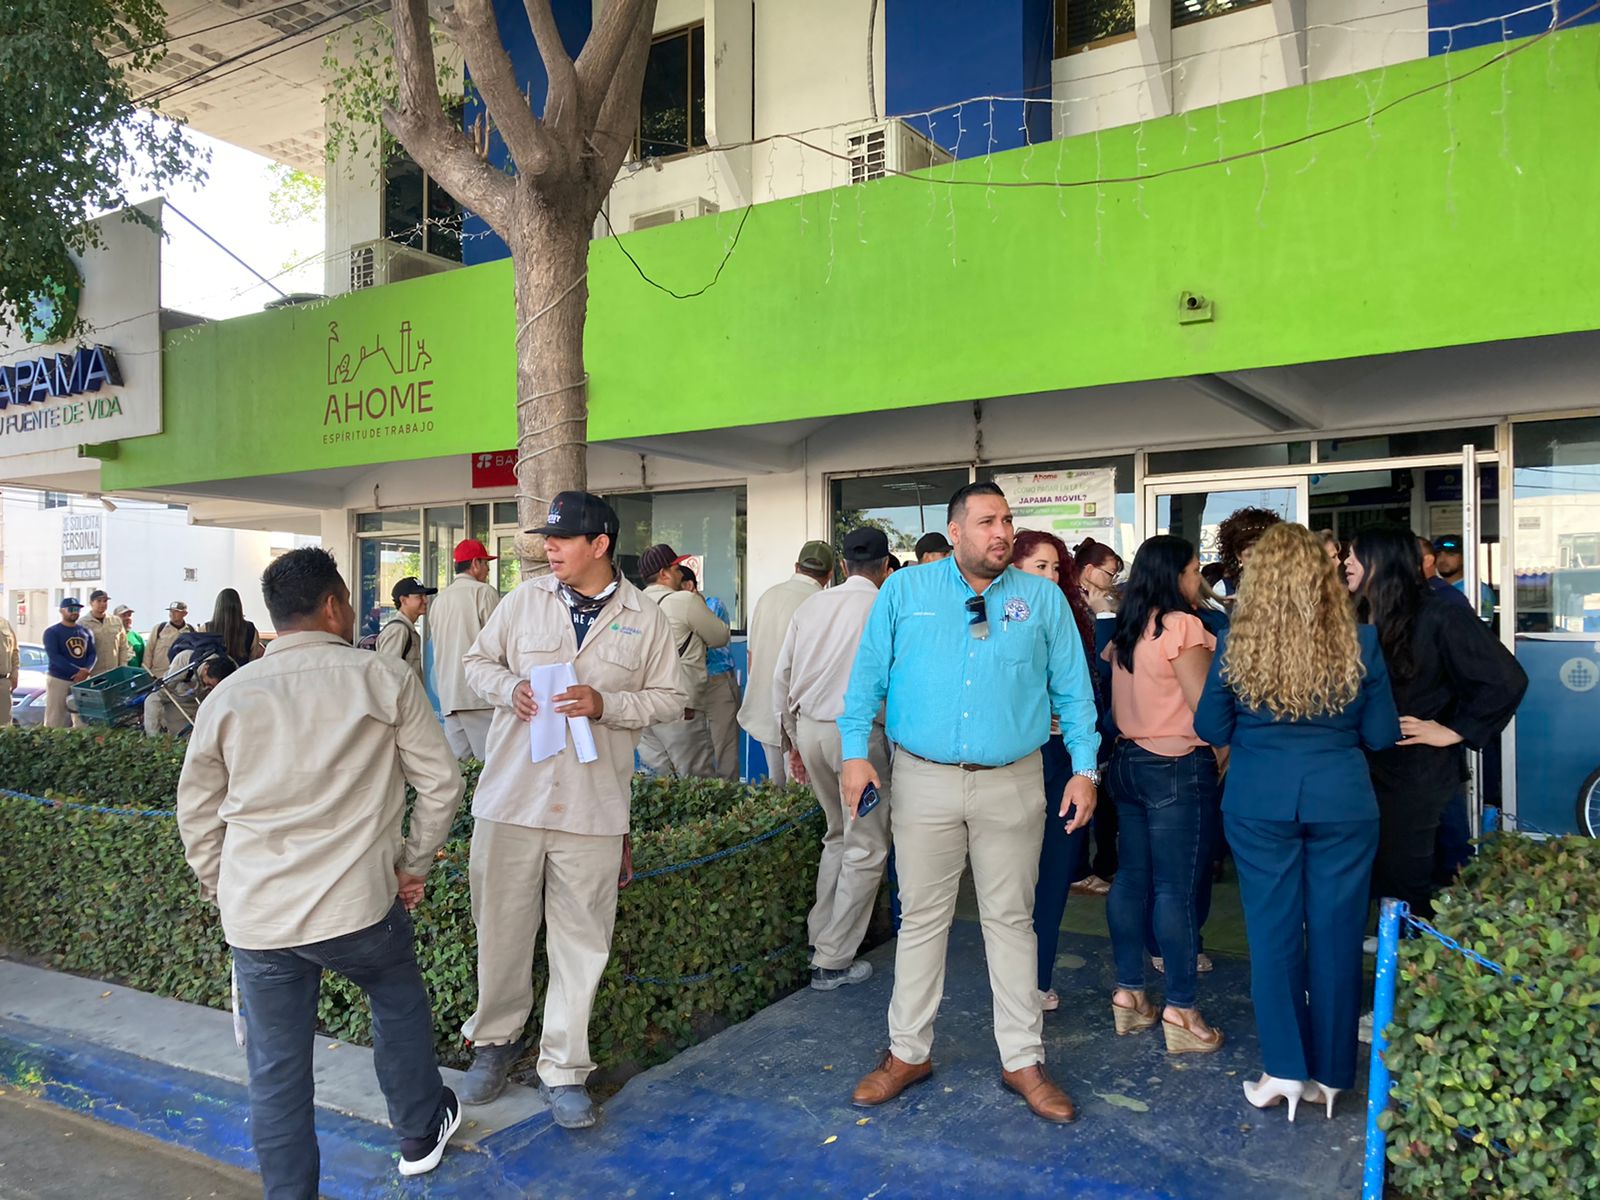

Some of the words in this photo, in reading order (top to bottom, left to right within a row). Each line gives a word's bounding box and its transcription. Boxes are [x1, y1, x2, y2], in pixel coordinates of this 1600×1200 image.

[323, 380, 434, 425] AHOME
[6, 407, 60, 434] FUENTE
[63, 402, 84, 425] DE
[87, 396, 123, 420] VIDA
[369, 427, 381, 438] DE
[385, 420, 434, 436] TRABAJO
[1018, 496, 1053, 504] JAPAMA
[70, 515, 99, 531] SOLICITA
[64, 531, 99, 550] PERSONAL
